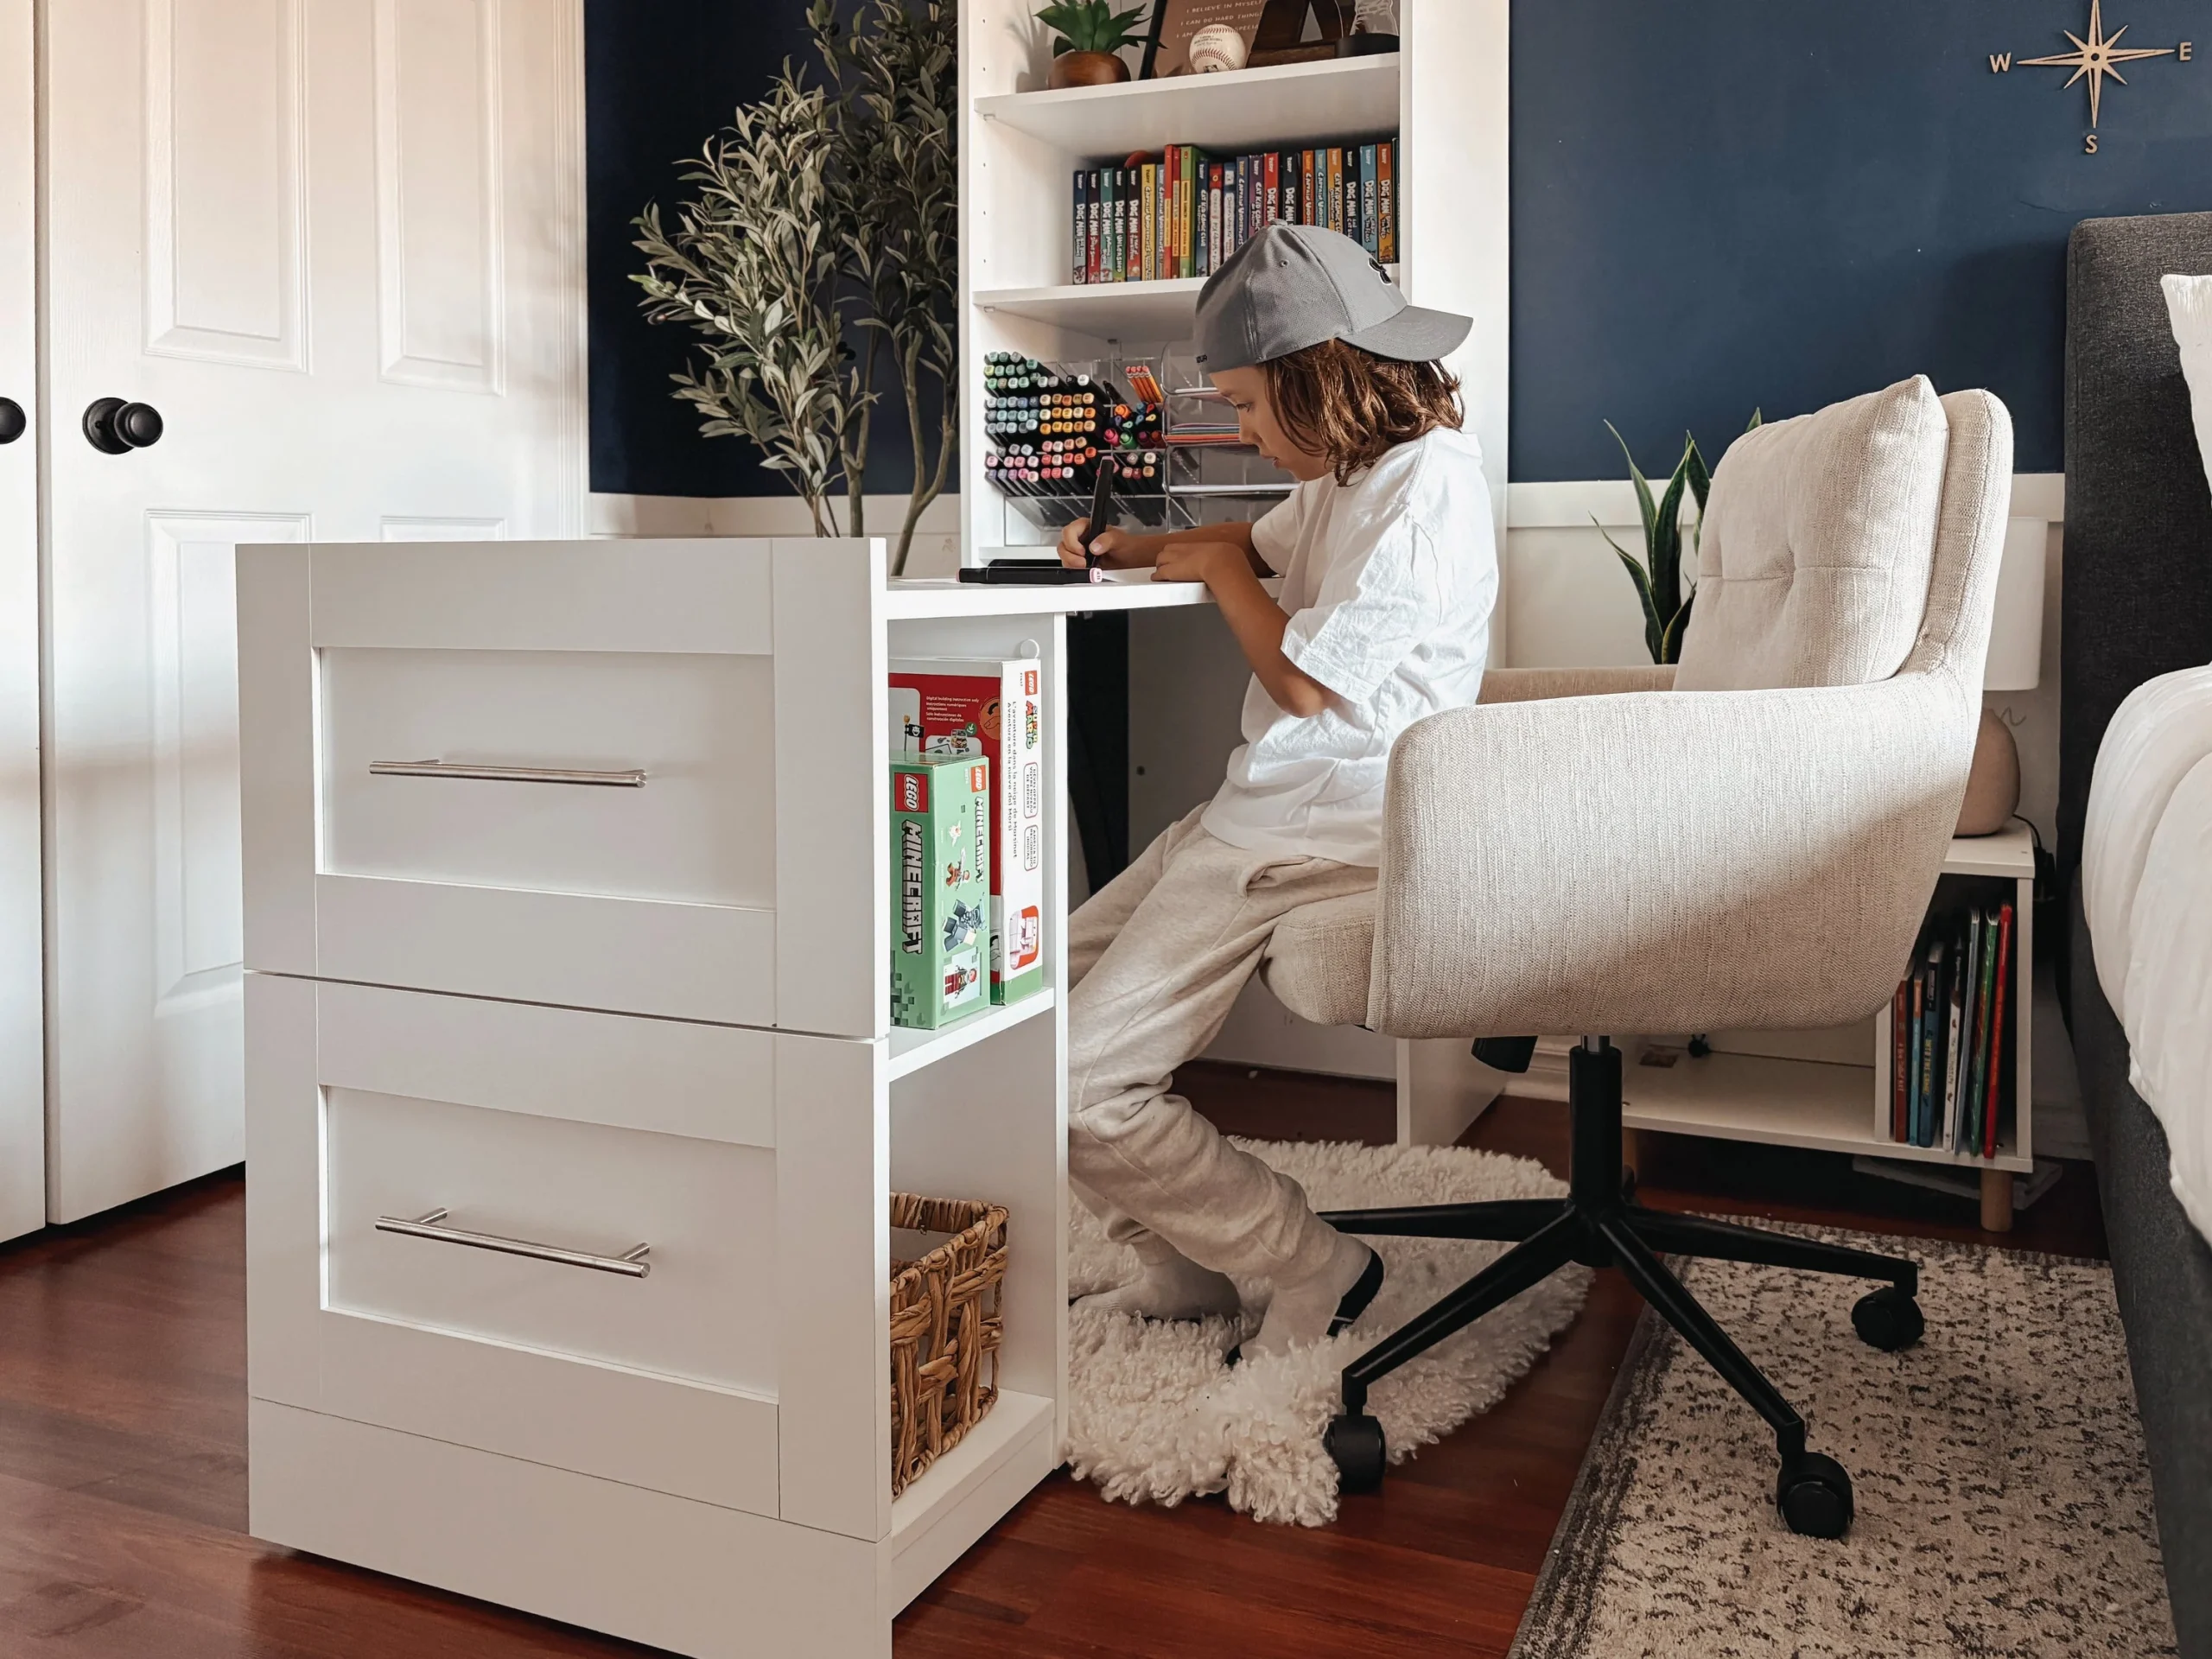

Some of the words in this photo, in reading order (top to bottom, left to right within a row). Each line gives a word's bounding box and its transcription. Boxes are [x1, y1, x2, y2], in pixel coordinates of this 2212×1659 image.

[2179, 41, 2192, 60] E
[1990, 52, 2012, 73] W
[2085, 134, 2098, 154] S
[1267, 188, 1275, 205] DOG
[1285, 188, 1294, 204] DOG
[1346, 181, 1356, 199] DOG
[1364, 180, 1374, 198] DOG
[1380, 179, 1390, 197] DOG
[1090, 203, 1099, 219] DOG
[1103, 201, 1111, 218] DOG
[1115, 200, 1124, 217] DOG
[1129, 200, 1139, 217] DOG
[1346, 200, 1356, 216] MAN
[1365, 199, 1374, 214] MAN
[1380, 198, 1390, 213] MAN
[1090, 220, 1098, 236] MAN
[1129, 217, 1138, 233] MAN
[1007, 744, 1011, 754] en
[906, 774, 918, 810] LEGO
[1013, 808, 1017, 818] de
[975, 797, 984, 884] MINECRAFT
[902, 819, 923, 954] MINECRAFT
